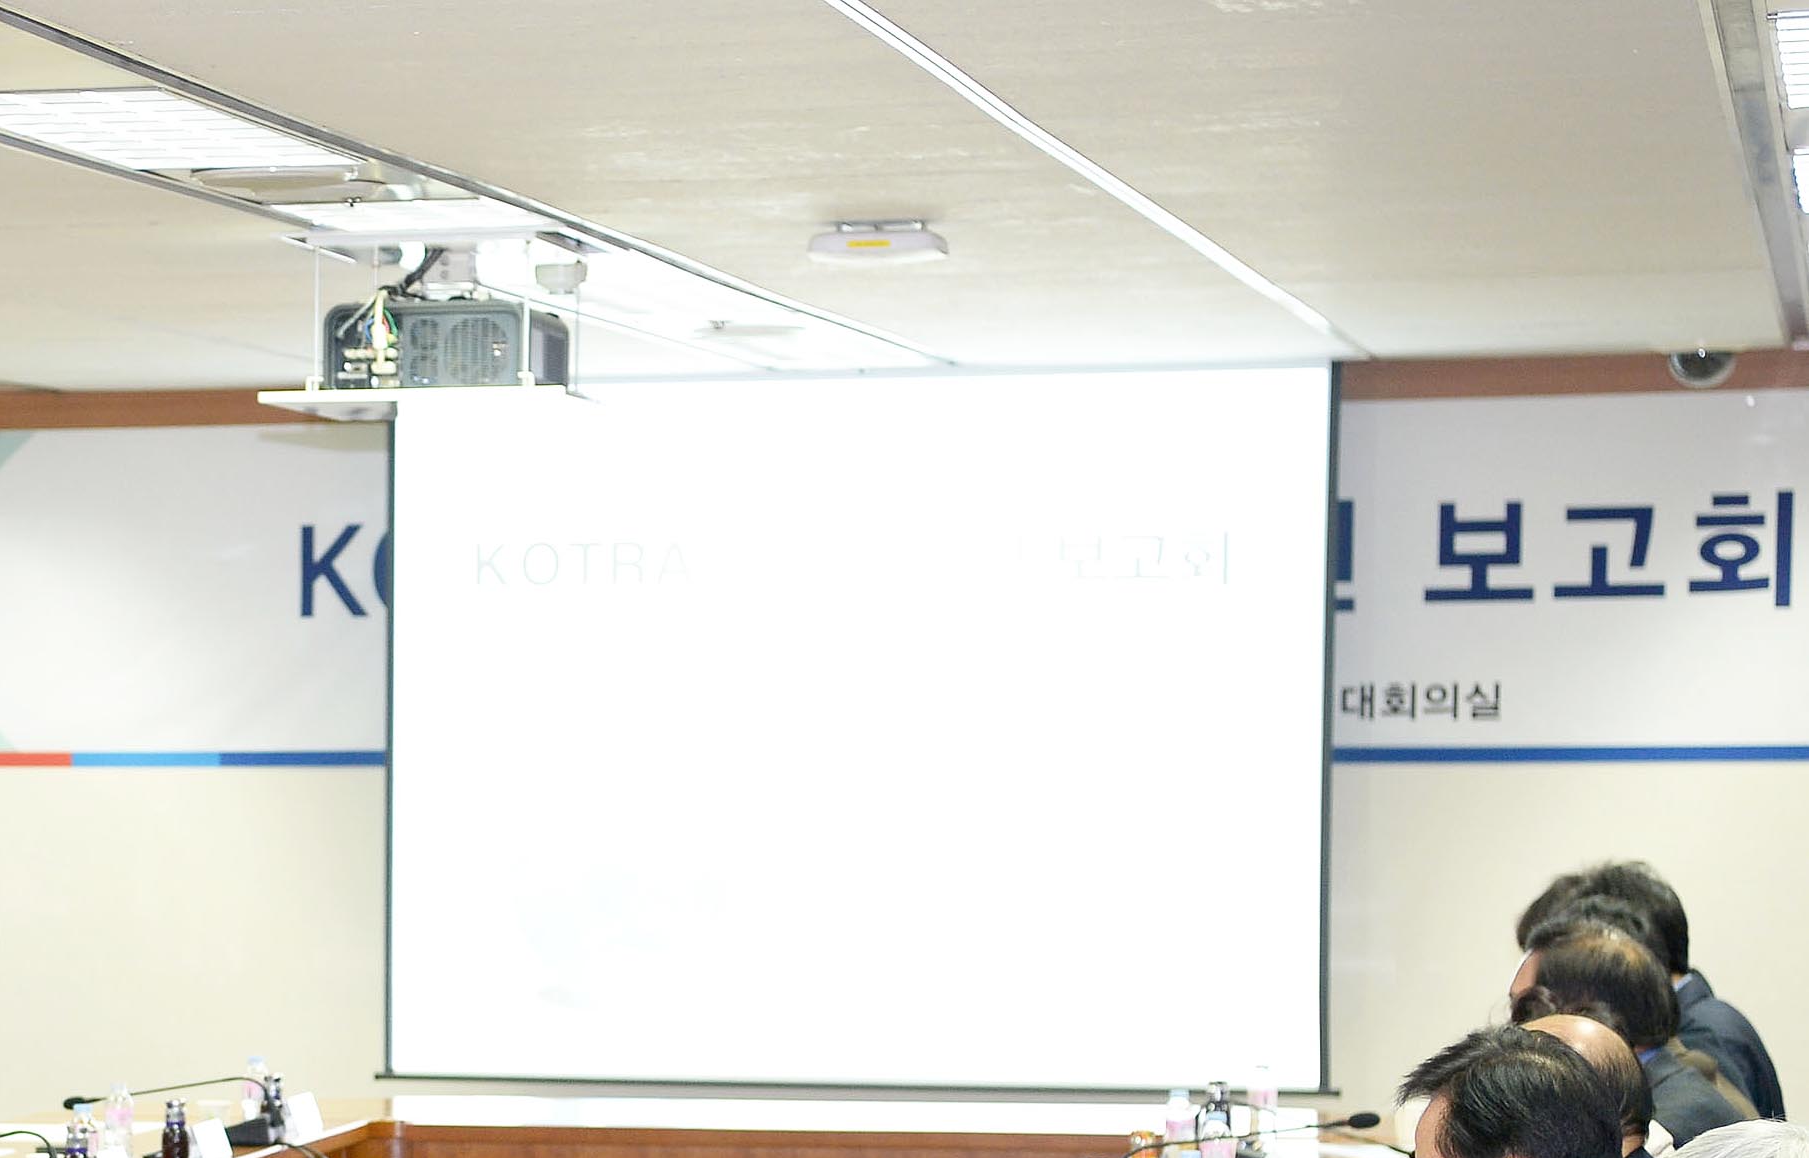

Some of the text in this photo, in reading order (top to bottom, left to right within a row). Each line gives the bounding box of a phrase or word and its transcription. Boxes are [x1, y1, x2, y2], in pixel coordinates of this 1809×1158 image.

[300, 524, 391, 617] K
[475, 540, 694, 586] KOTRA
[1423, 489, 1795, 608] 보고회
[1340, 681, 1502, 721] 대회의실
